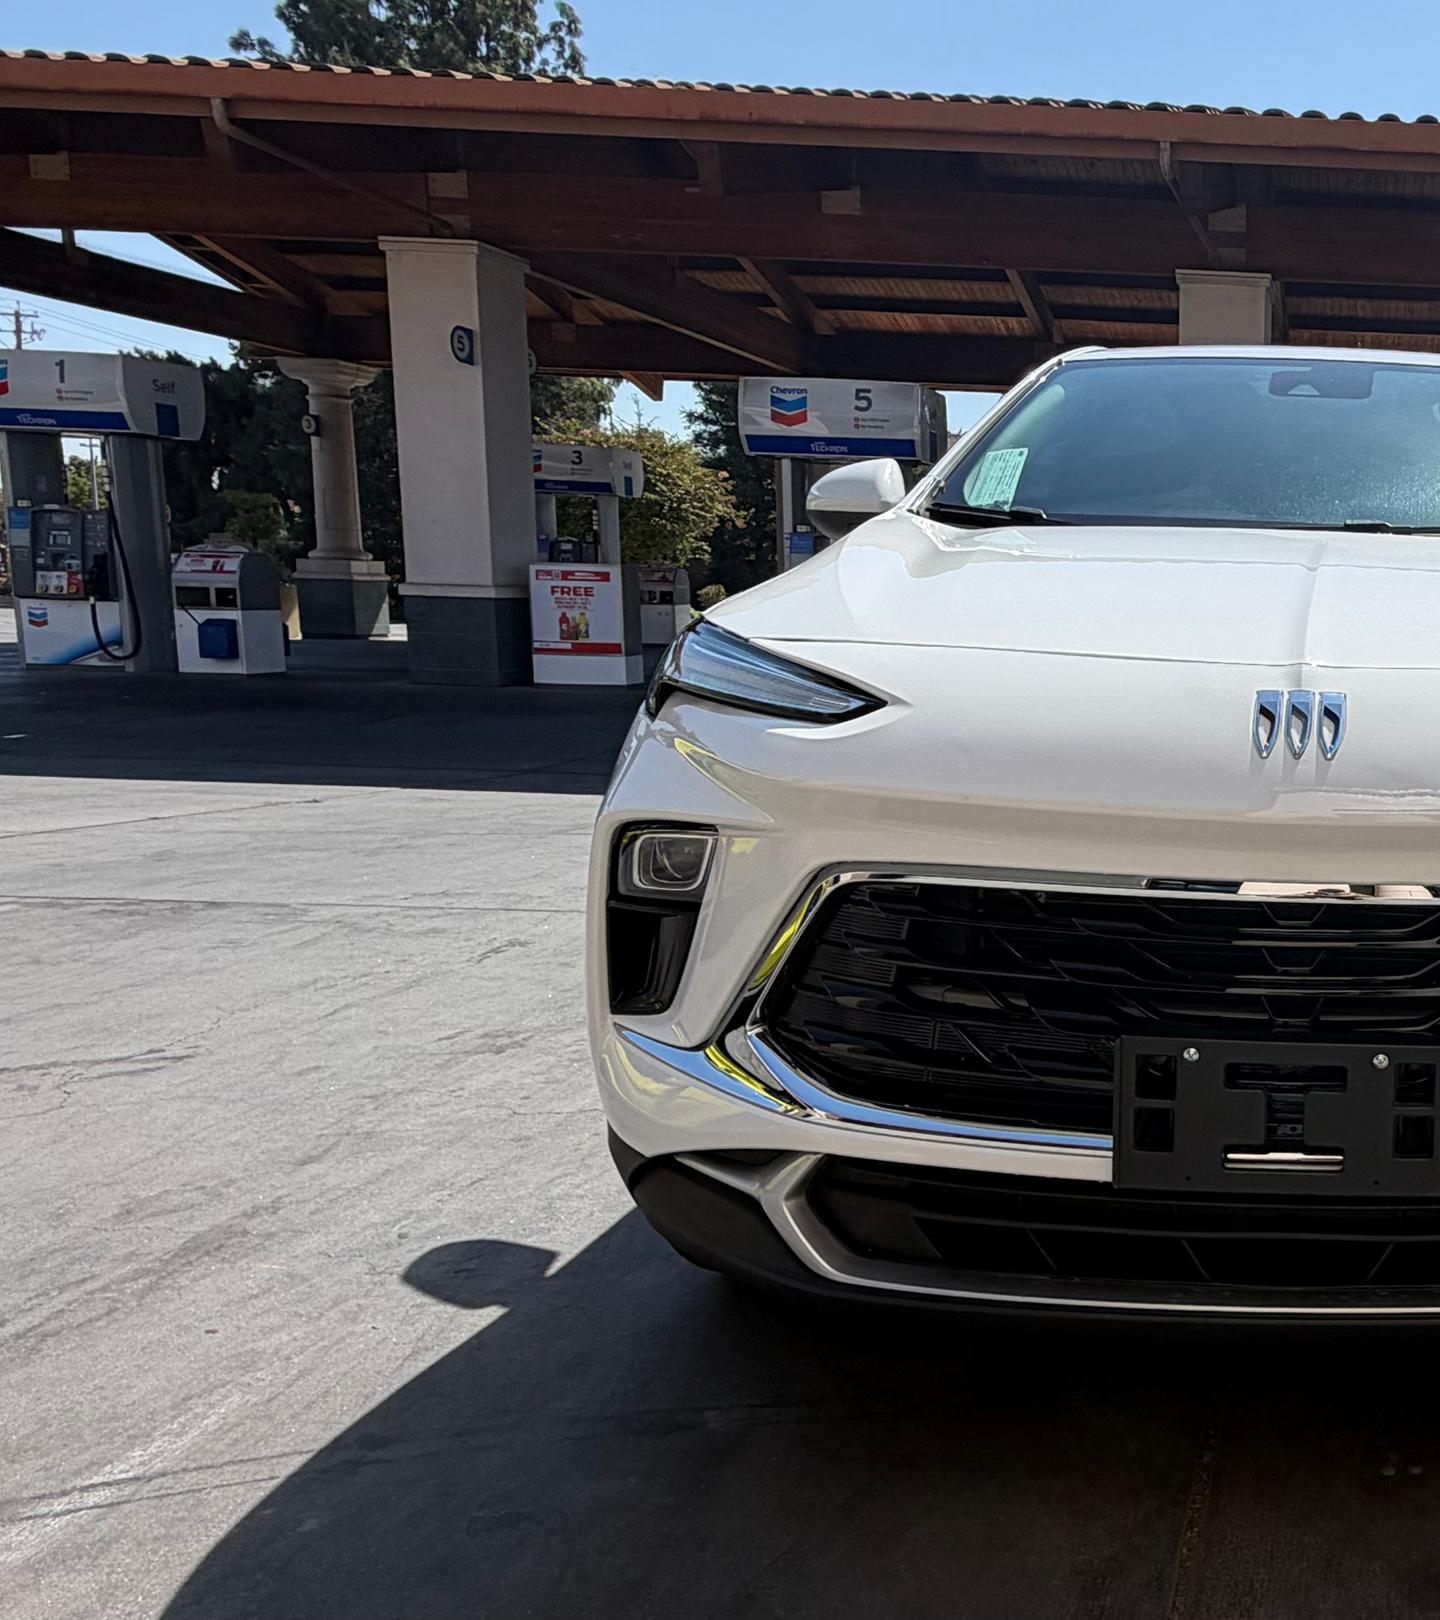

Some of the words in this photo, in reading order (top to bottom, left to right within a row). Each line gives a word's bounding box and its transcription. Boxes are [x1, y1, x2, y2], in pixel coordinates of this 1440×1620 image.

[456, 334, 466, 353] 5
[54, 359, 66, 384] 1
[152, 379, 176, 395] Self
[769, 385, 808, 396] Chevron
[853, 388, 873, 412] 5
[303, 417, 313, 430] 3
[570, 450, 583, 466] 3
[550, 585, 595, 597] FREE
